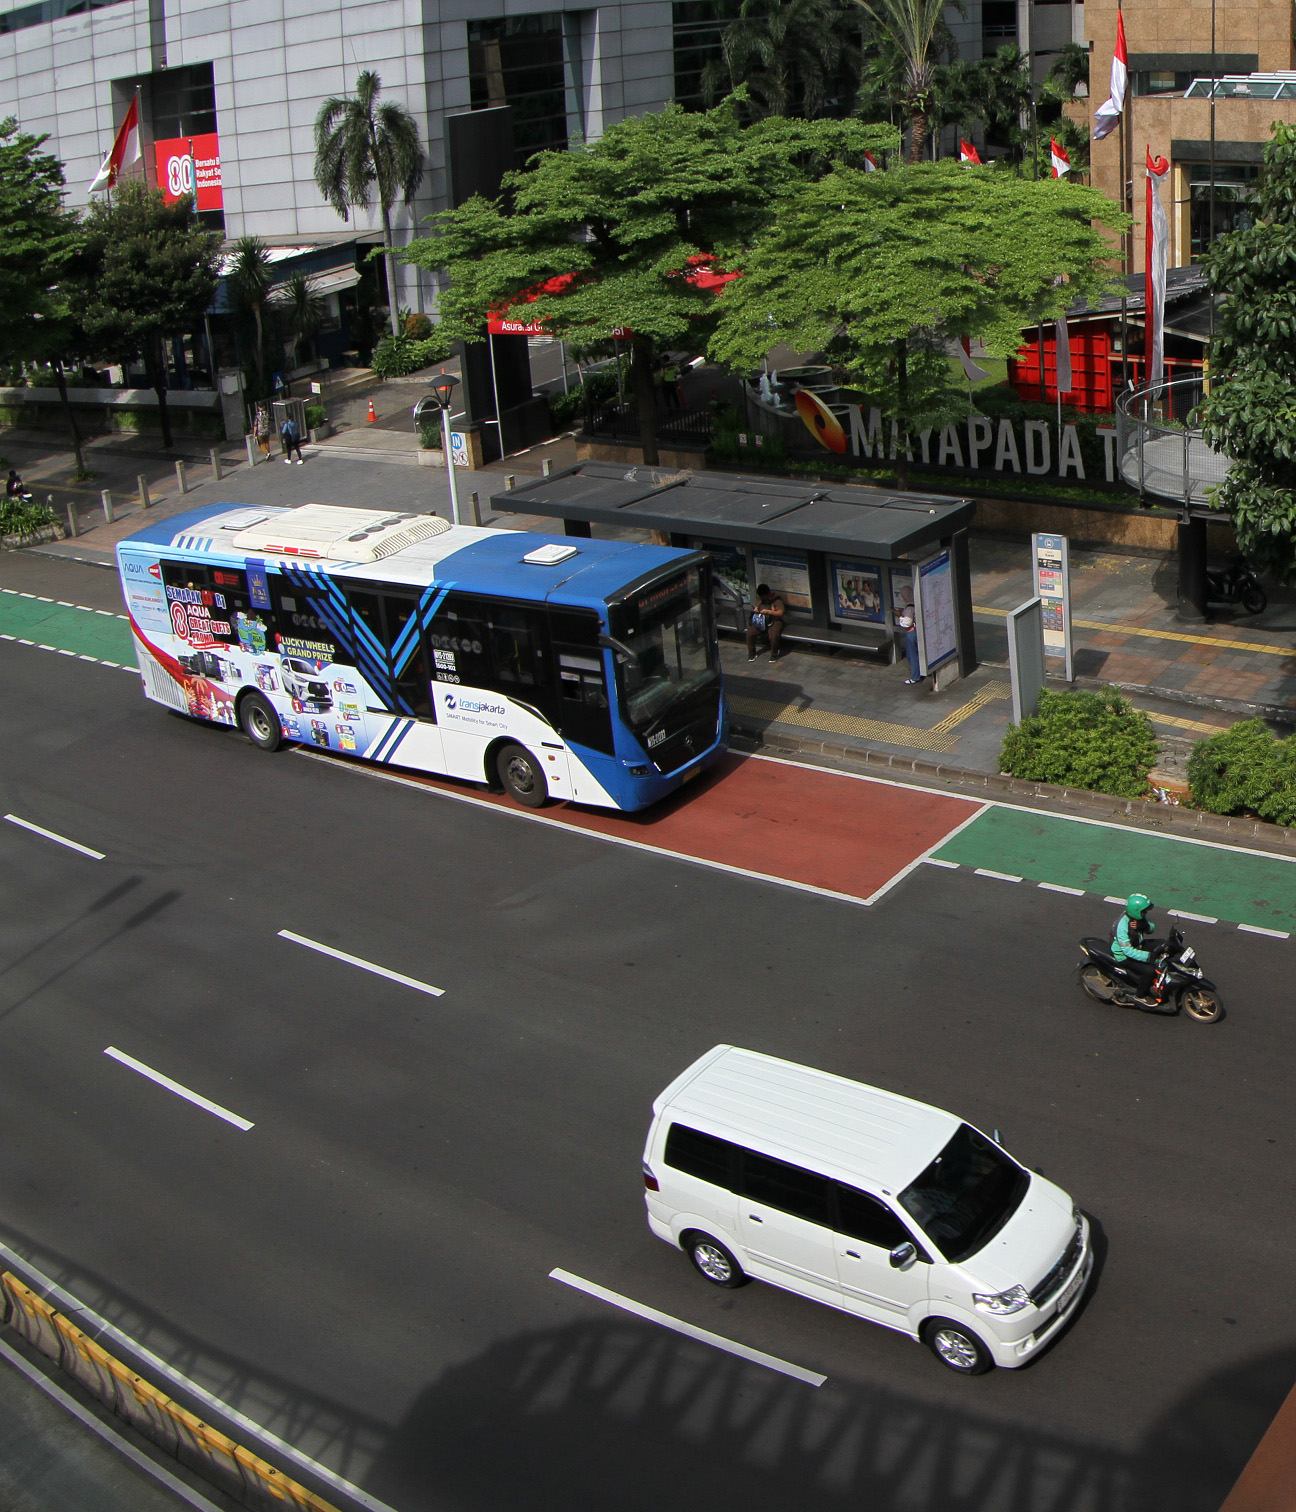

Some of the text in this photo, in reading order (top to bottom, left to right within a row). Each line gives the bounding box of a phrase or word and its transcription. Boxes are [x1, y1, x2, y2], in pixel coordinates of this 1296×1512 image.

[195, 159, 216, 168] Bersatu
[168, 154, 193, 196] 80
[196, 169, 214, 179] Rakyat
[196, 178, 222, 188] Indonesia
[124, 563, 144, 574] AQUA
[187, 605, 211, 619] AQUA
[188, 617, 232, 635] GREAT GIFTS
[281, 636, 336, 653] LUCKY WHEELS
[287, 647, 334, 662] GRAND PRIZE
[459, 698, 506, 715] transjakarta
[446, 712, 461, 720] SMART
